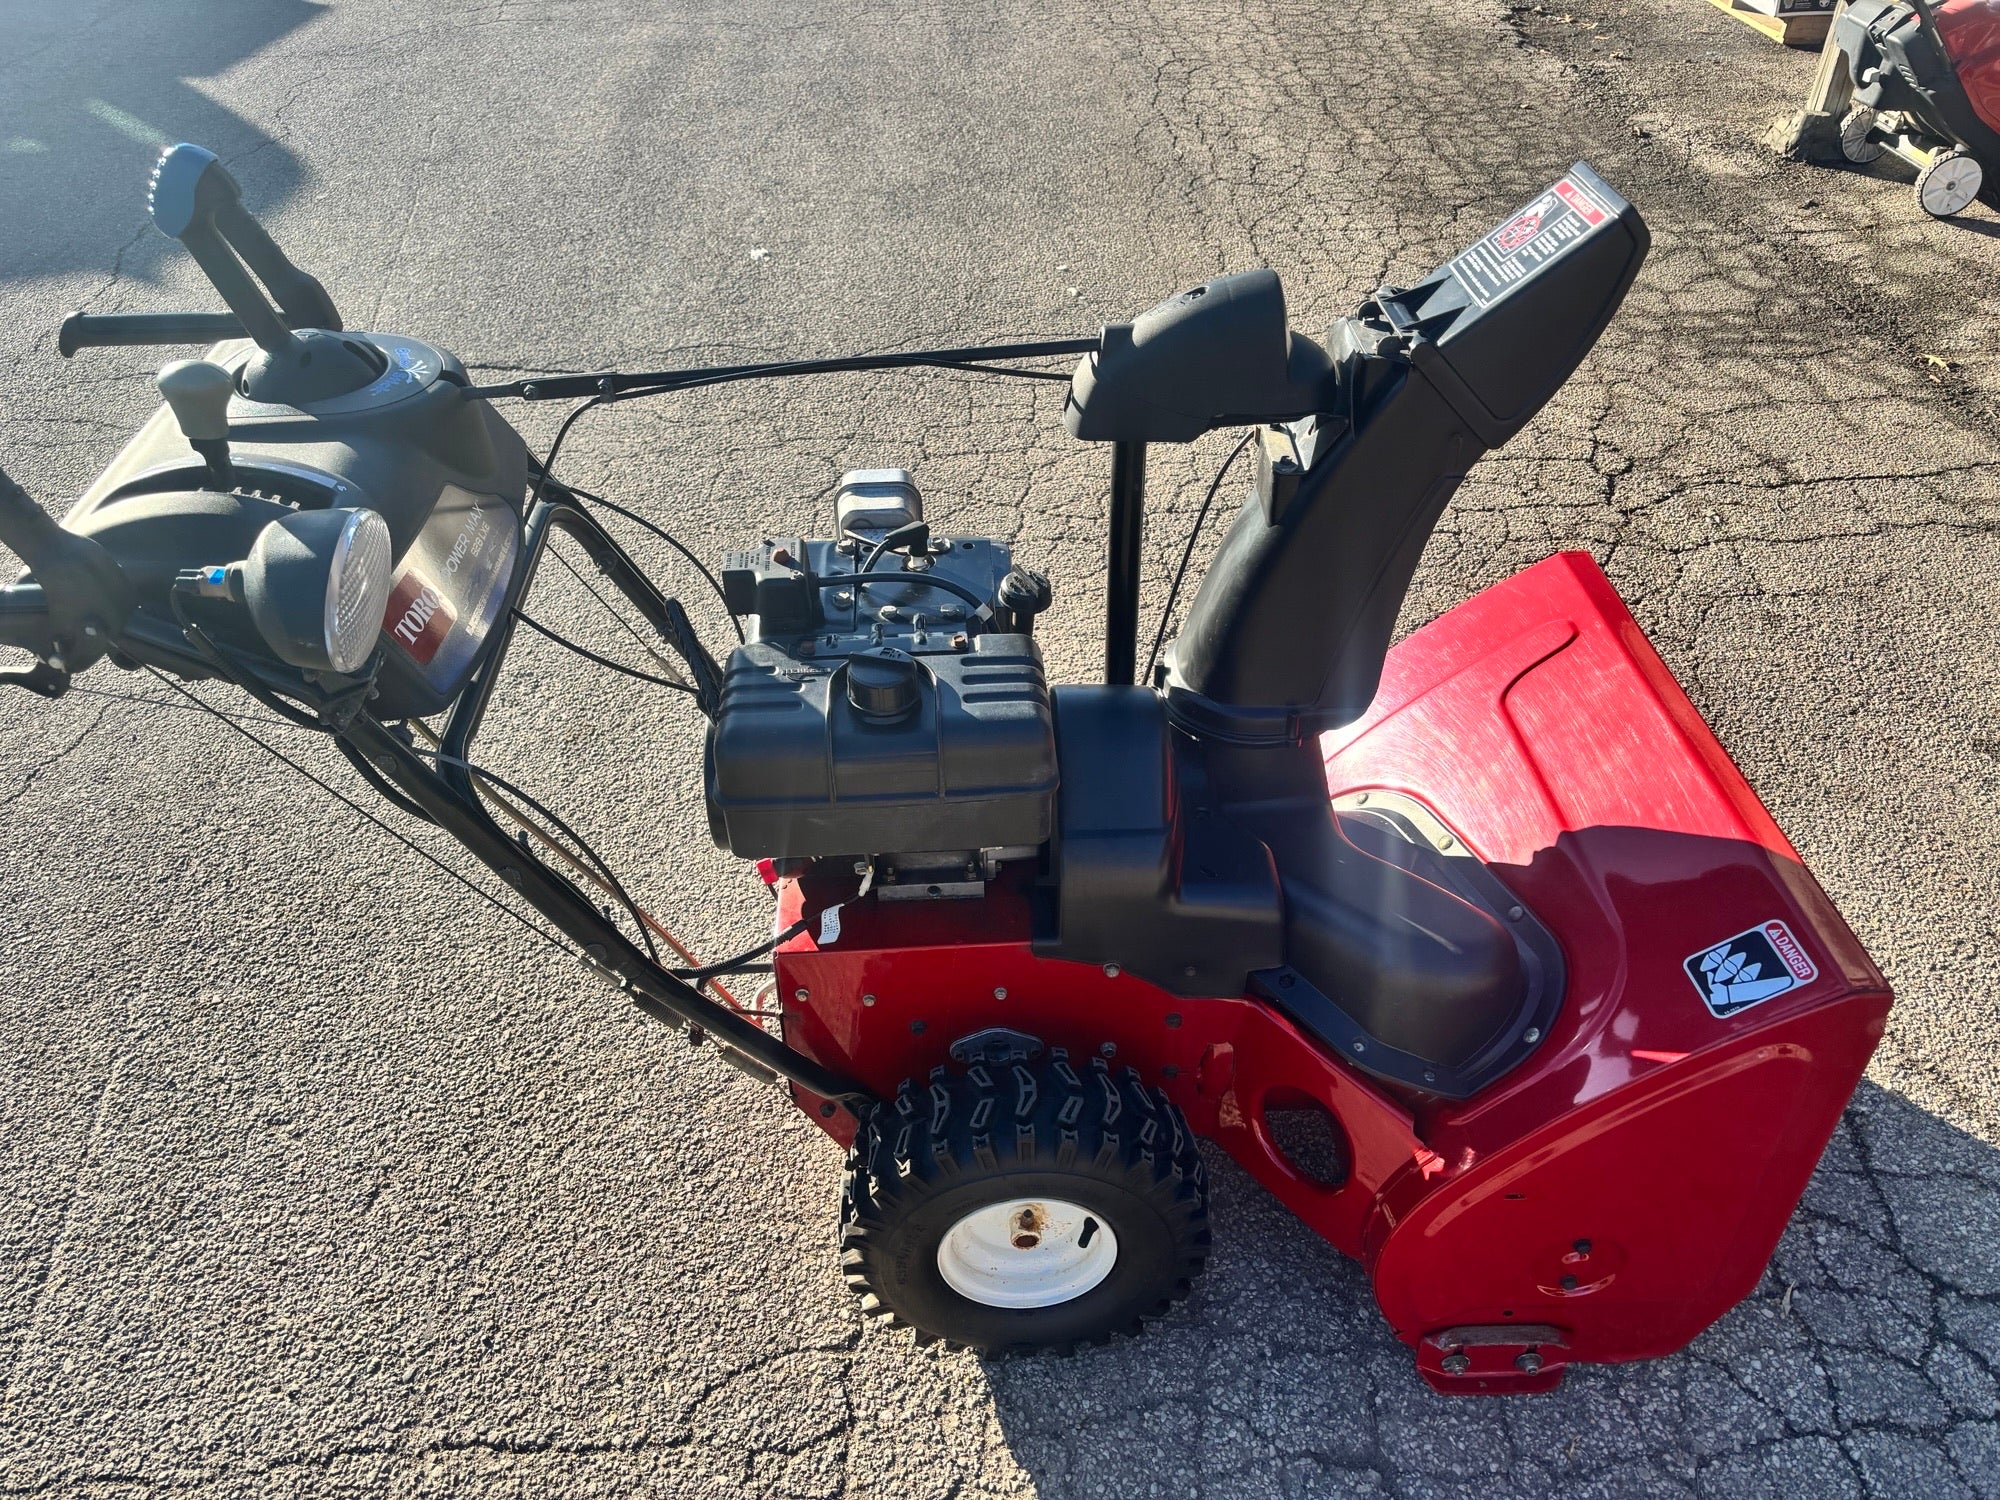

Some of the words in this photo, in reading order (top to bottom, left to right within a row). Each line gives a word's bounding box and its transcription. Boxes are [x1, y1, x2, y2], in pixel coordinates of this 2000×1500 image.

[440, 533, 471, 579] POWER
[464, 502, 485, 535] MAX
[470, 536, 484, 559] 828
[393, 585, 442, 646] TORO
[1775, 936, 1812, 978] DANGER
